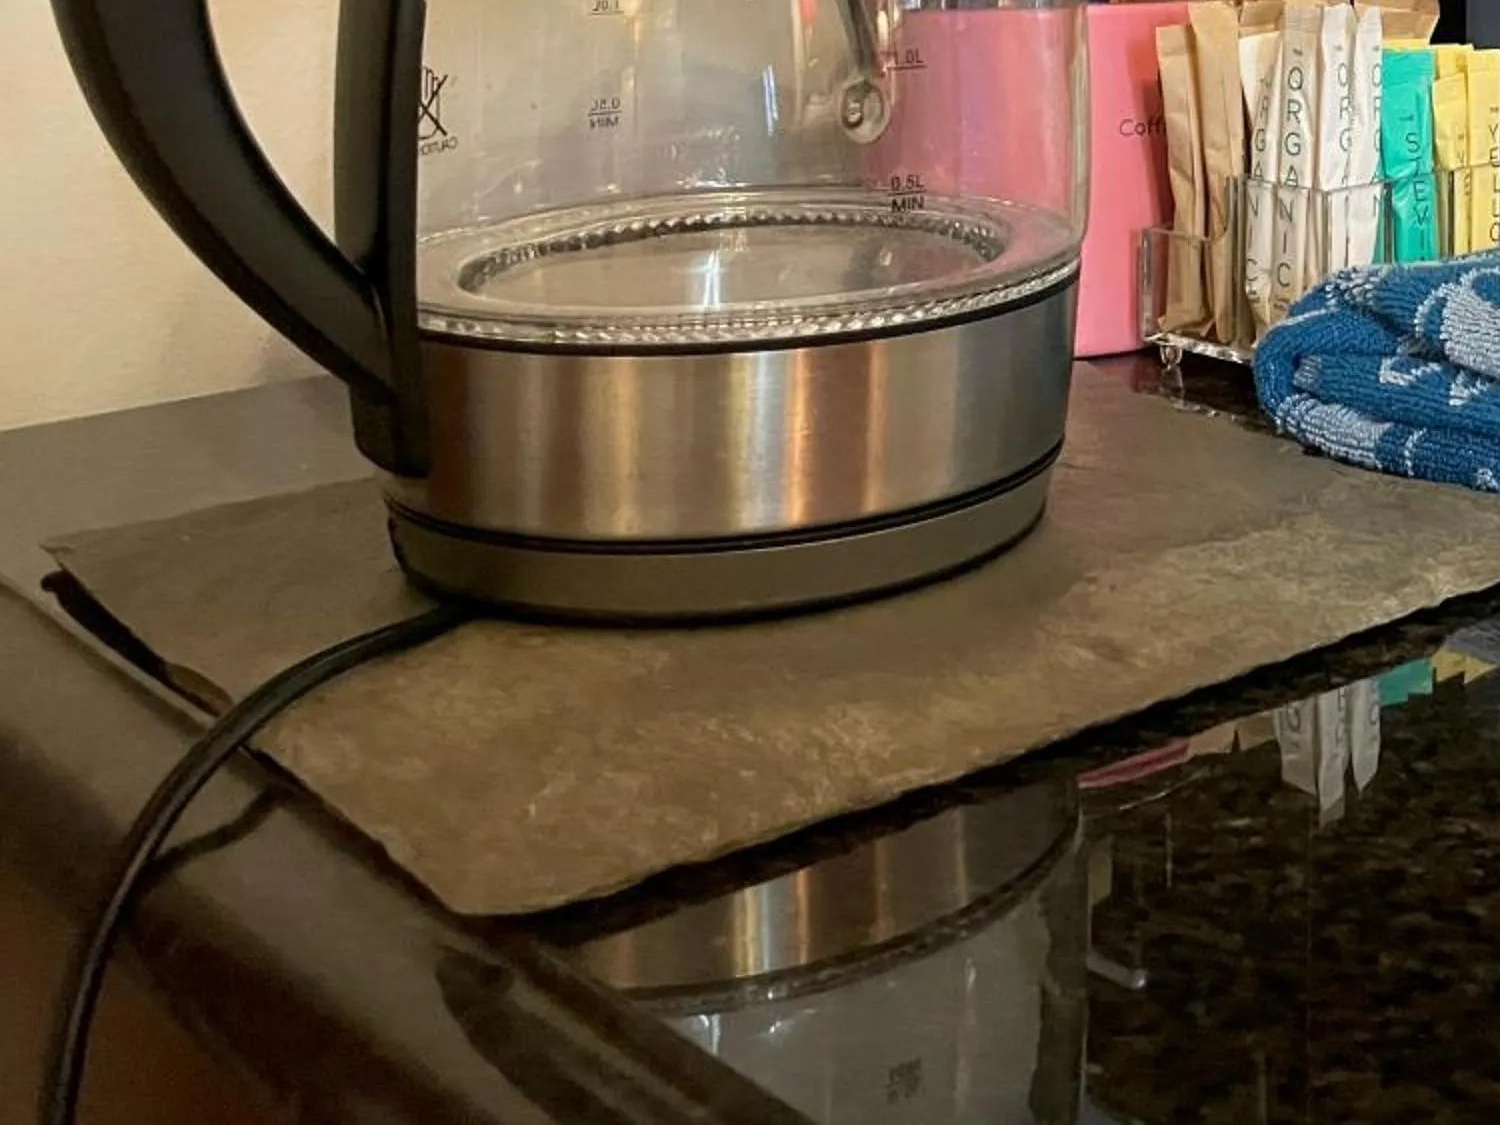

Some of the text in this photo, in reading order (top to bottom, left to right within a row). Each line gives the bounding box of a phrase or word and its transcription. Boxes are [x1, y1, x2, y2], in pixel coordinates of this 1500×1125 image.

[1119, 115, 1167, 137] Coff
[891, 195, 925, 213] MIN
[1277, 66, 1304, 288] ORGANIC
[1404, 132, 1429, 260] STEVI
